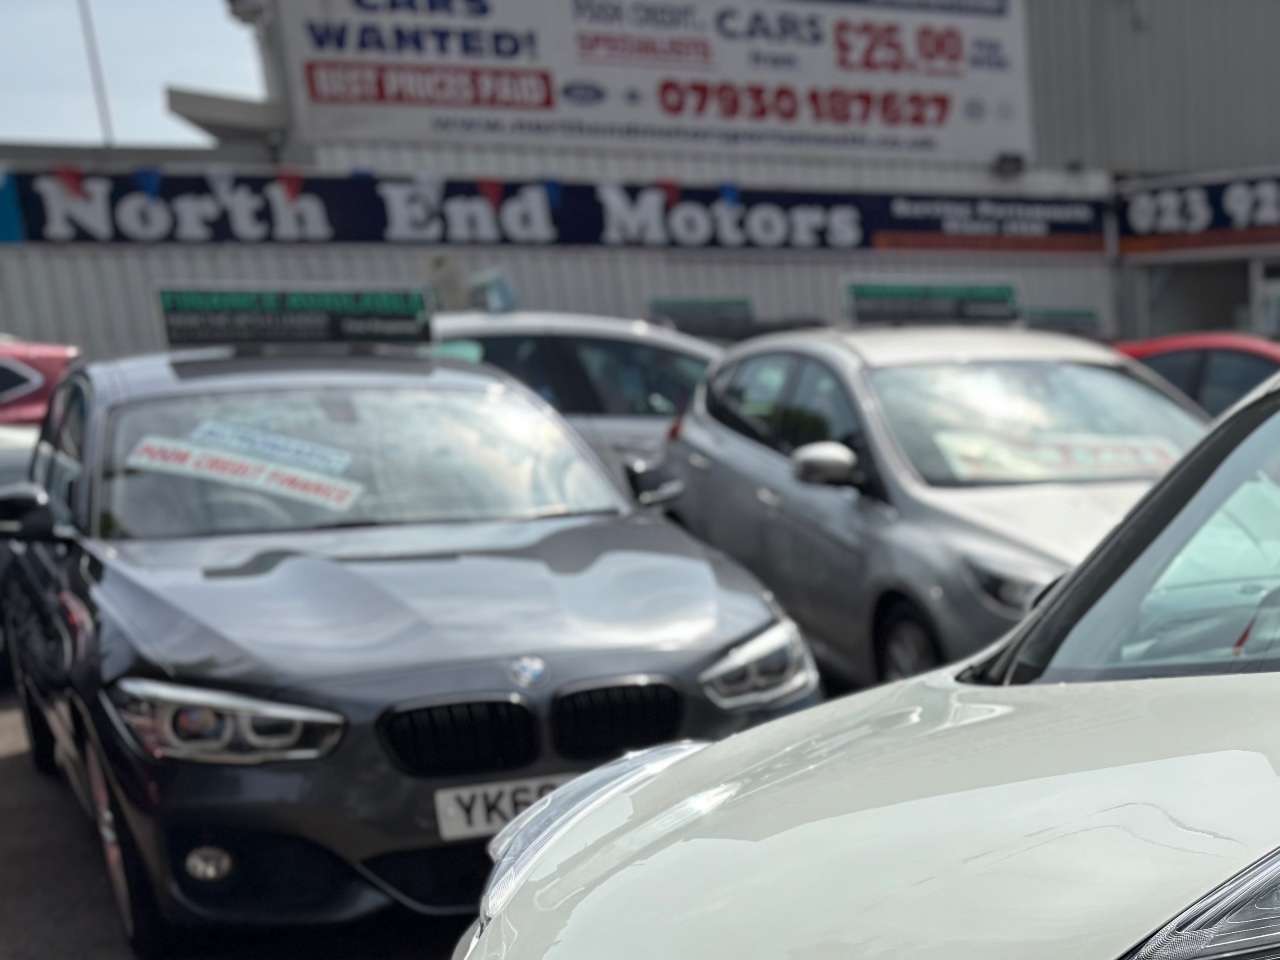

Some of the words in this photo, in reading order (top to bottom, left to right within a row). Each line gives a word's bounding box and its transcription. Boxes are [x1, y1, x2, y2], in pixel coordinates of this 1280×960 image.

[305, 20, 538, 60] WANTED!
[715, 7, 822, 46] CARS
[35, 177, 333, 243] North
[378, 178, 558, 243] End
[597, 184, 863, 249] Motors
[1127, 191, 1213, 235] 023
